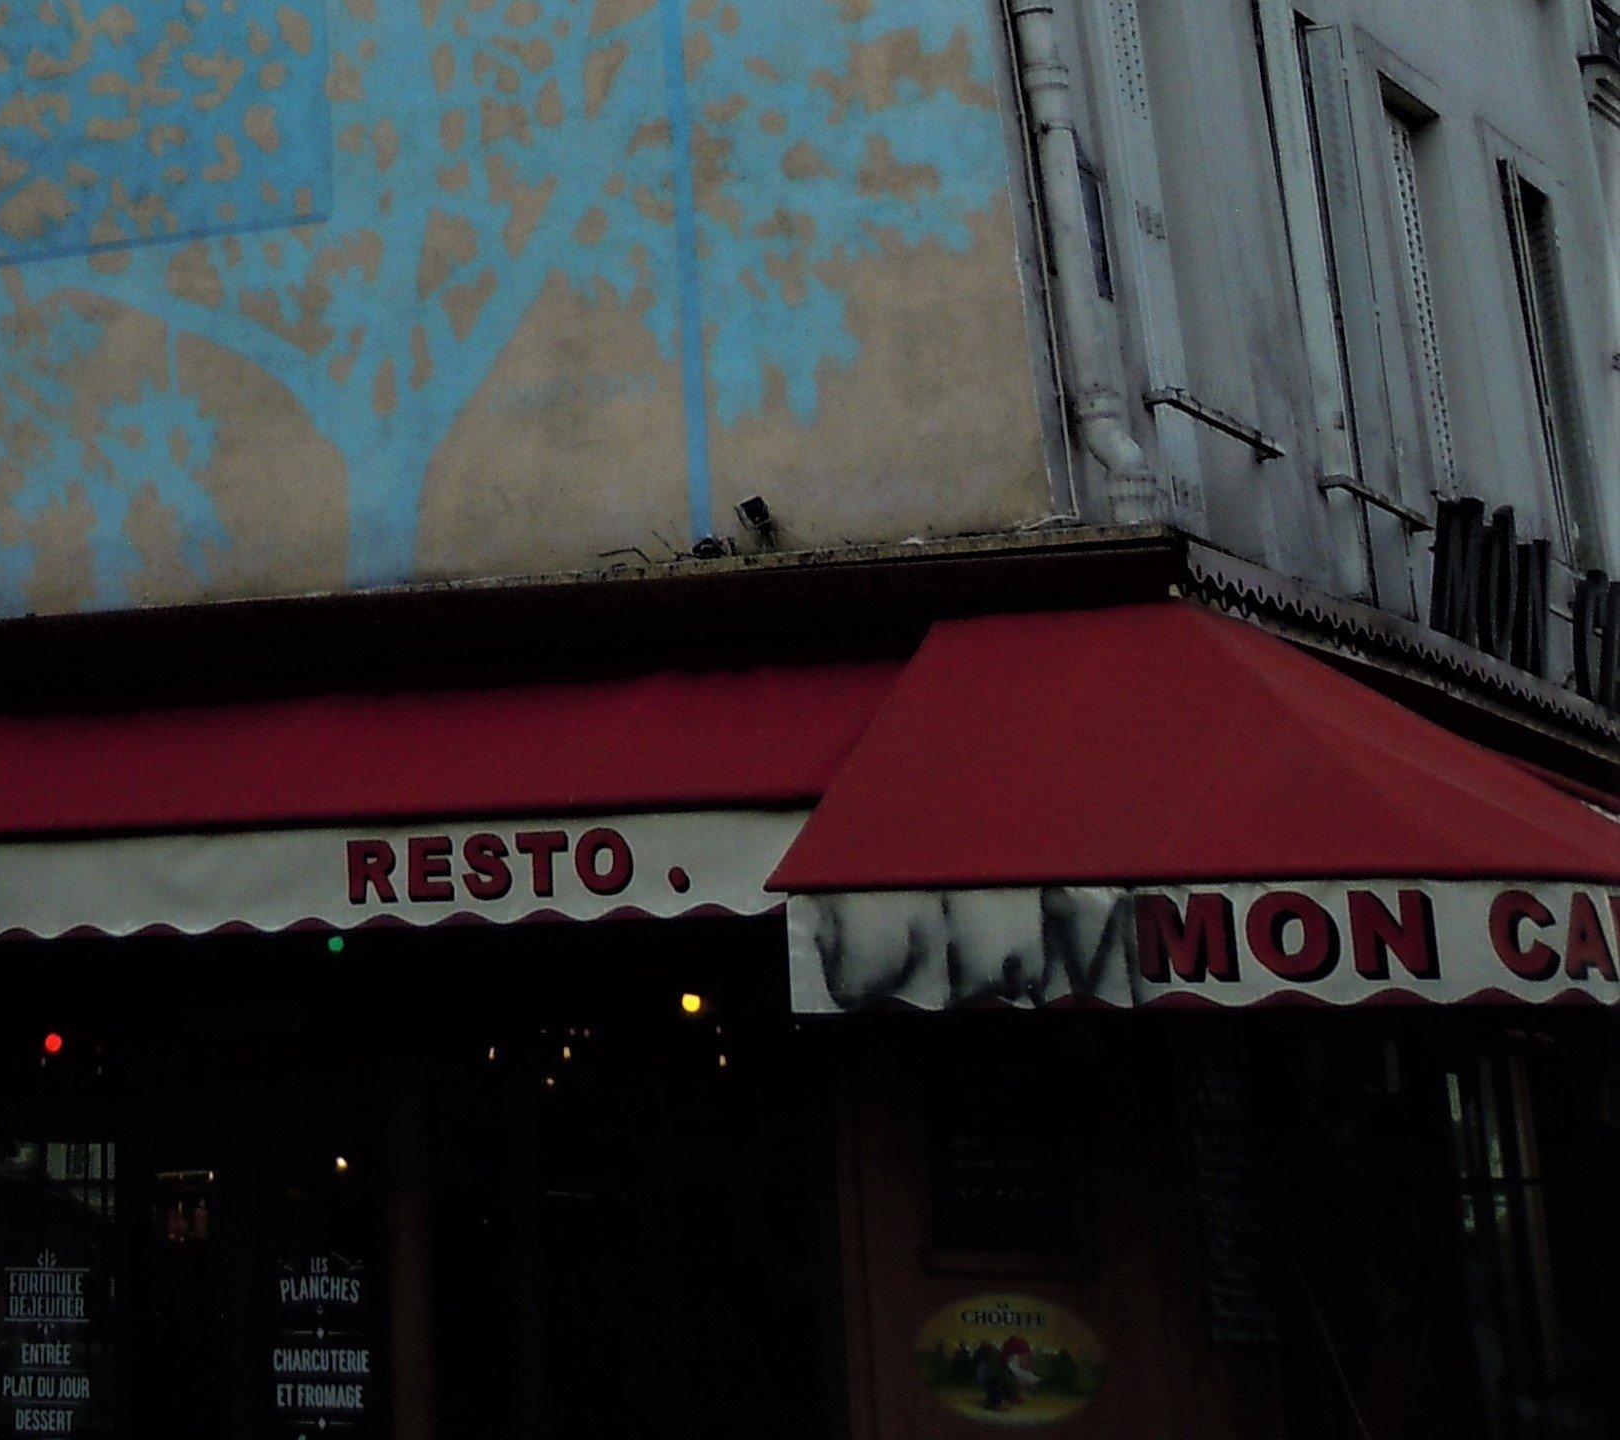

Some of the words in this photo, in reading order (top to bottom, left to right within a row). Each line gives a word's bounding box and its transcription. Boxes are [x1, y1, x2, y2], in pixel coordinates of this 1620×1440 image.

[1134, 888, 1439, 983] MON
[1489, 889, 1620, 983] CA
[310, 1256, 328, 1273] LES
[9, 1272, 84, 1295] FORMULE
[280, 1276, 360, 1303] PLANCHES
[21, 1340, 71, 1365] ENTRÉE
[273, 1348, 371, 1373] CHARCUTERIE
[3, 1375, 34, 1397] PLAT
[37, 1376, 55, 1397] DU
[57, 1376, 90, 1398] JOUR
[276, 1383, 295, 1407] ET
[297, 1384, 364, 1408] FROMAGE
[15, 1409, 74, 1431] DESSERT
